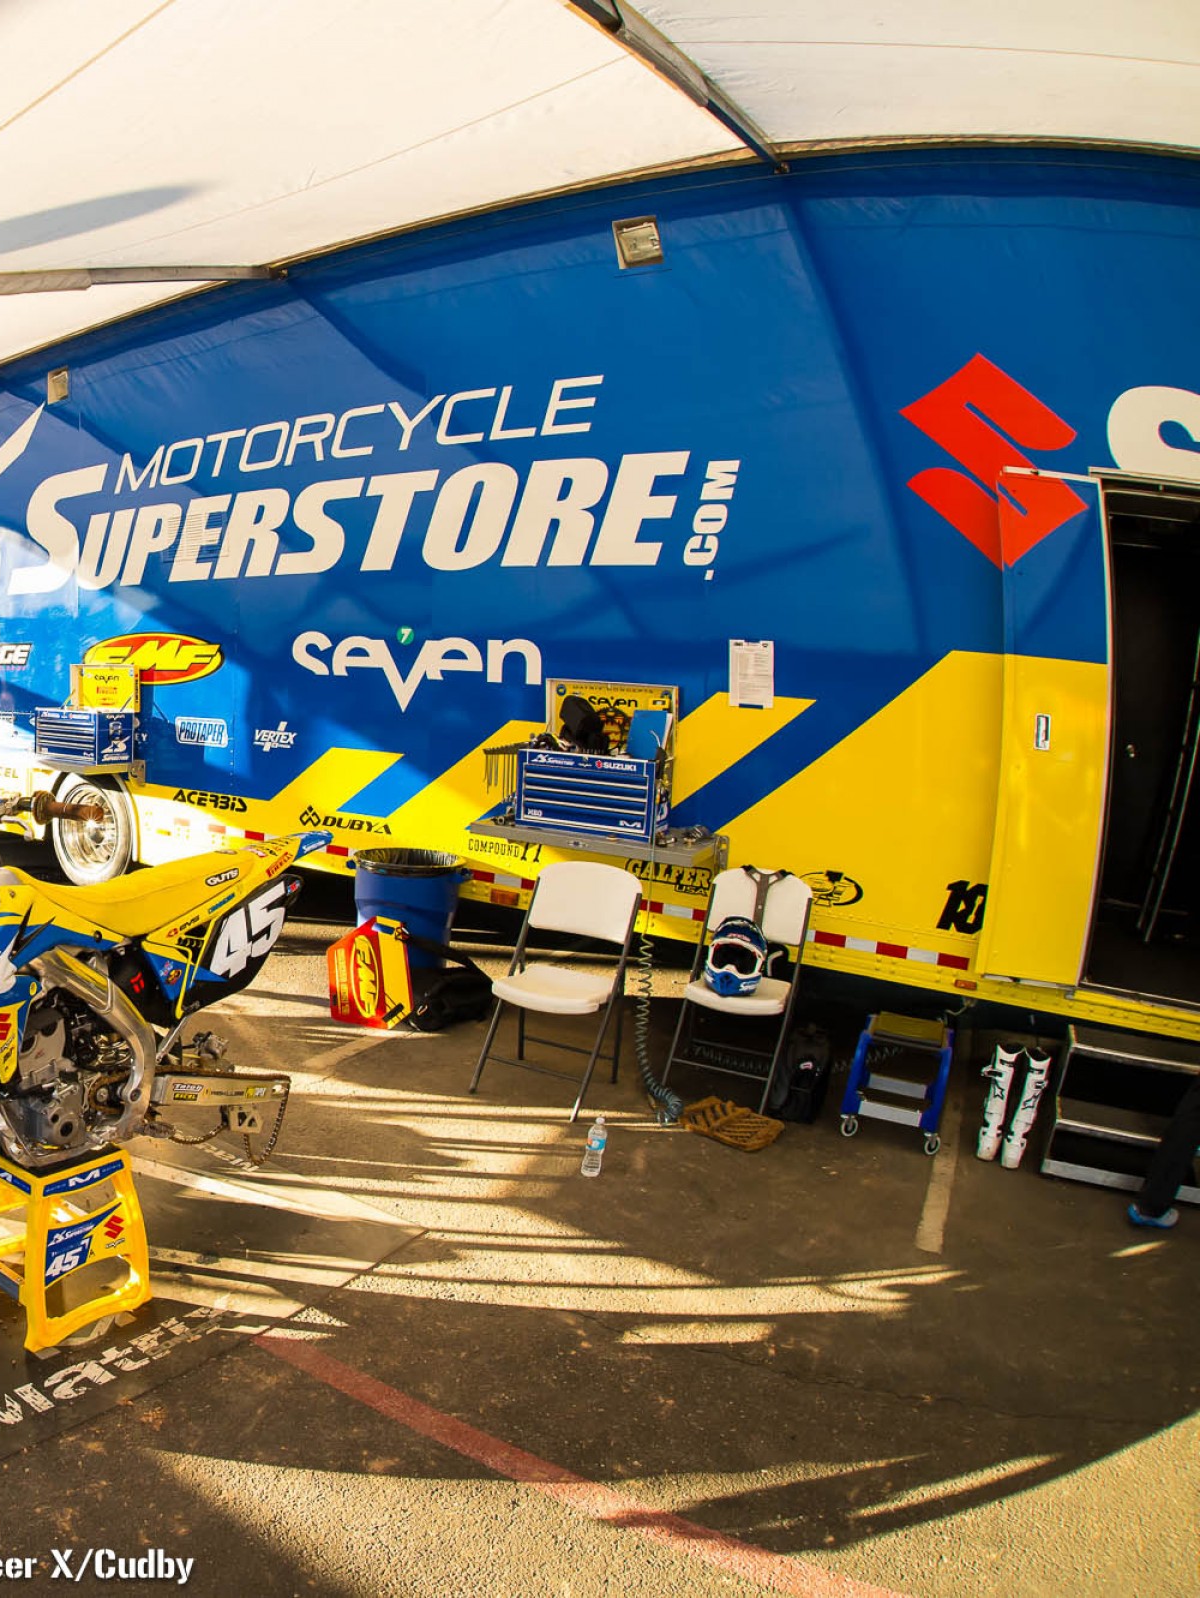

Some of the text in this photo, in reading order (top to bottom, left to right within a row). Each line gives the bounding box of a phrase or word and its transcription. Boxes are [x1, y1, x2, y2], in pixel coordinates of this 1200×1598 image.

[115, 374, 604, 494] MOTORCYCLE
[8, 450, 691, 597] SUPERSTORE
[682, 459, 740, 581] .COM
[86, 642, 220, 671] FMF
[253, 728, 298, 745] VERTEX
[603, 761, 637, 771] SUZUKI
[322, 815, 392, 835] DUBYA
[468, 838, 520, 858] COMPOUND
[206, 868, 239, 886] GUTS
[625, 859, 713, 887] GALFER
[673, 884, 708, 896] USA
[210, 881, 286, 979] 45
[45, 1246, 83, 1277] 45
